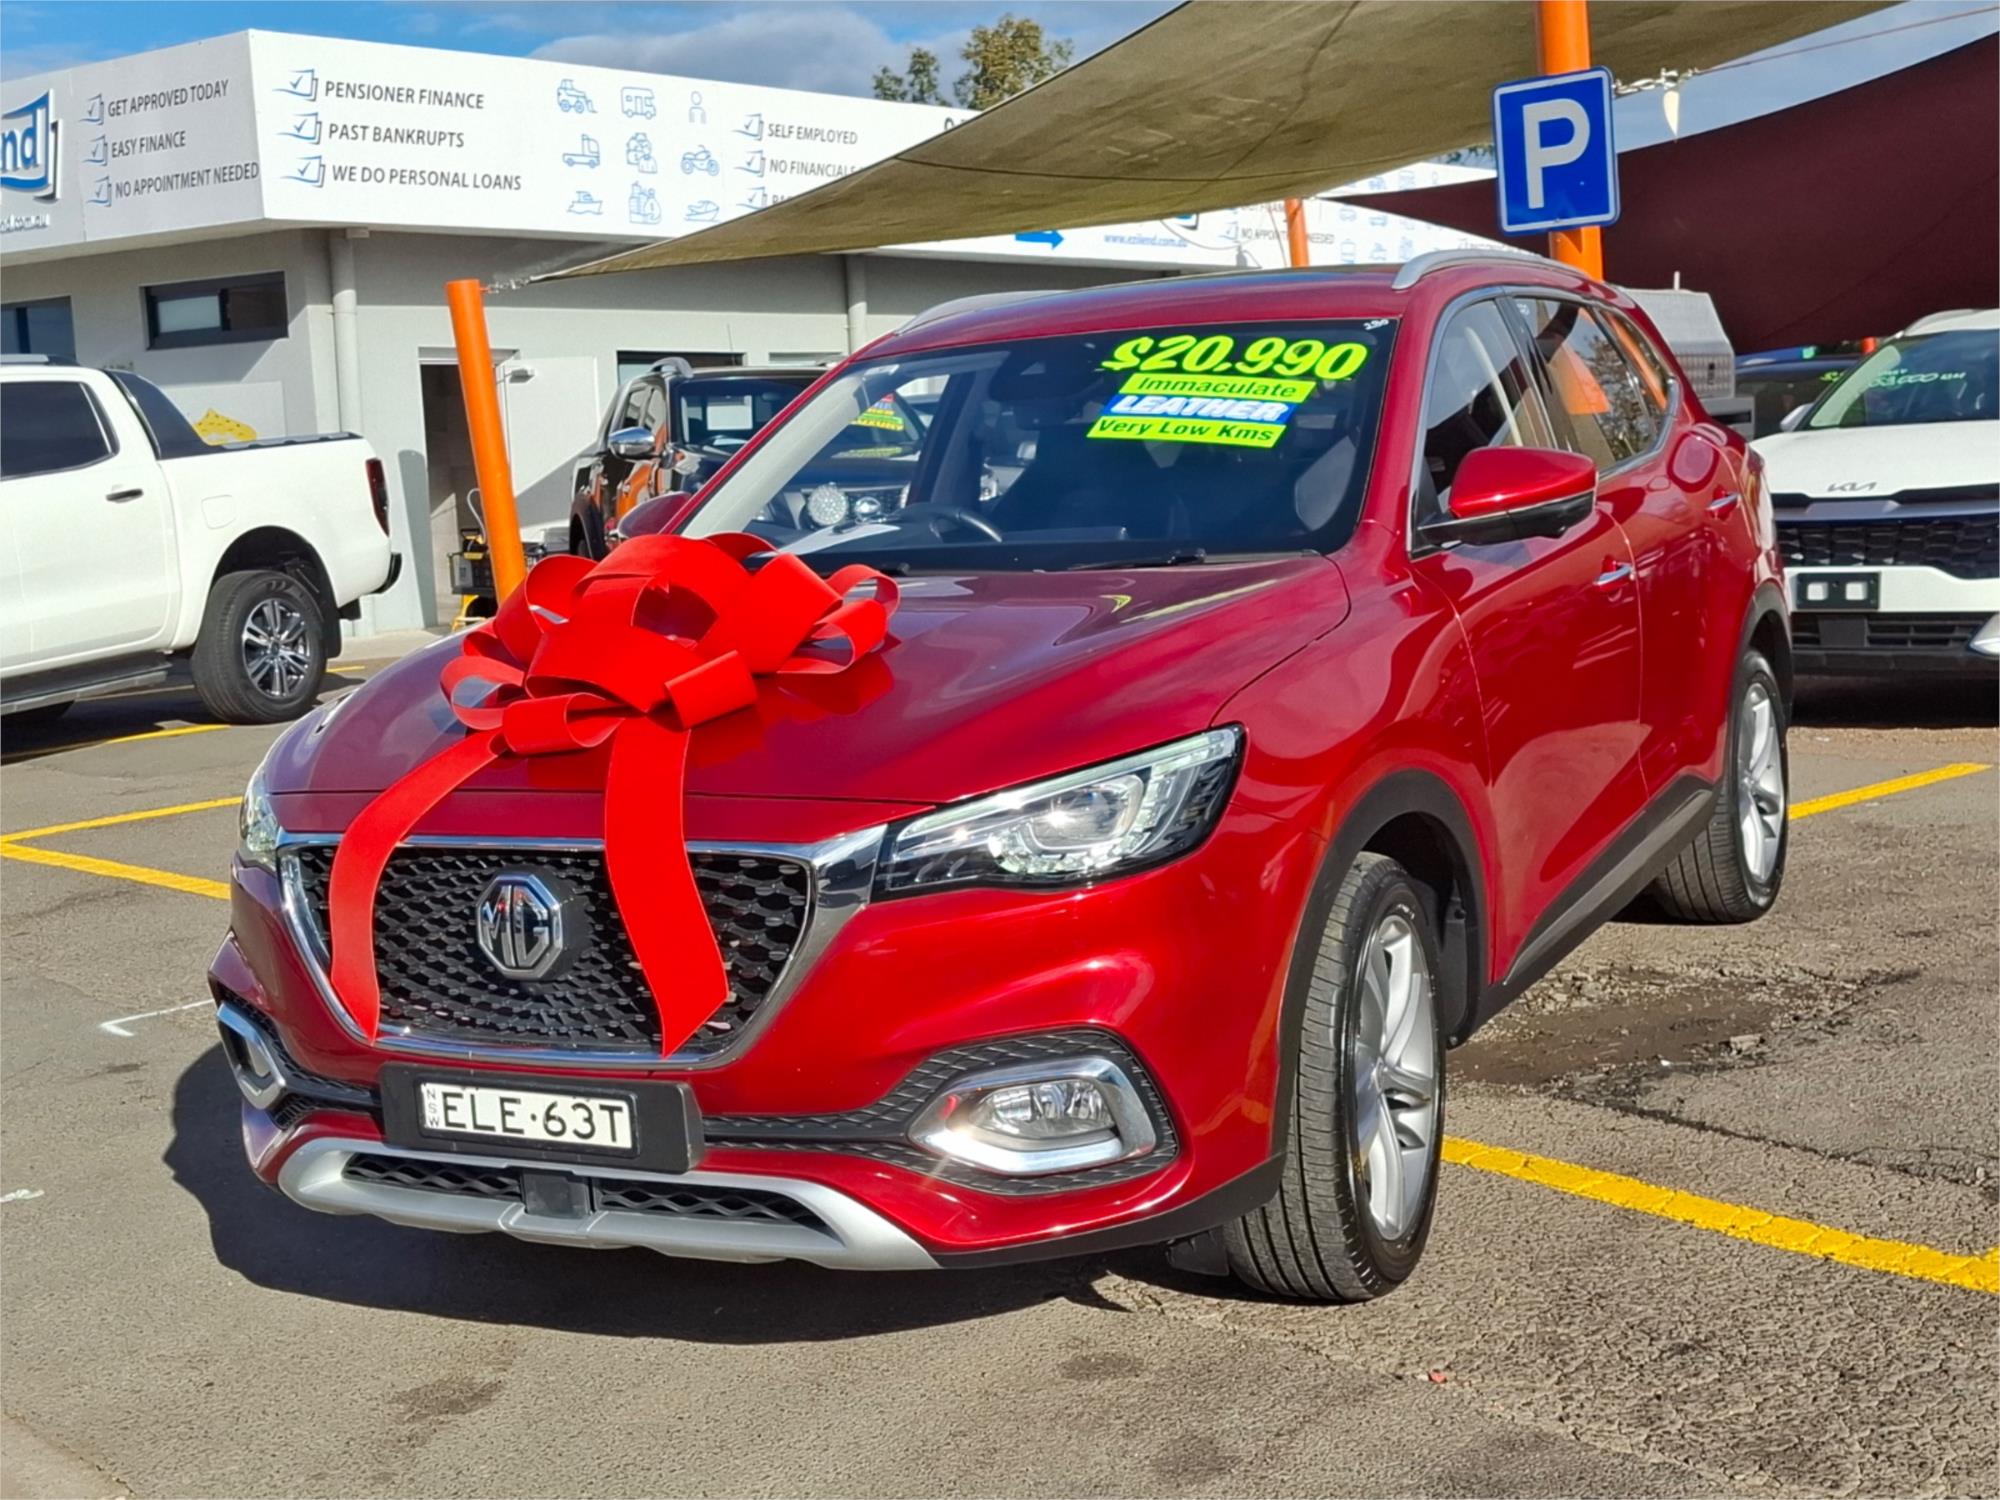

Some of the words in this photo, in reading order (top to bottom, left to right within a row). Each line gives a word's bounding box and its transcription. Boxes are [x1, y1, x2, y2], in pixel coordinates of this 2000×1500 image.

[108, 99, 128, 117] GET
[129, 88, 188, 114] APPROVED
[190, 79, 229, 103] TODAY
[325, 80, 415, 104] PENSIONER
[419, 89, 485, 109] FINANCE
[112, 137, 137, 158] EASY
[139, 130, 186, 153] FINANCE
[328, 123, 369, 141] PAST
[372, 126, 465, 148] BANKRUPTS
[767, 123, 793, 138] SELF
[796, 126, 858, 145] EMPLOYED
[769, 159, 787, 174] NO
[1522, 98, 1590, 209] P
[115, 181, 131, 199] NO
[133, 169, 211, 195] APPOINTMENT
[214, 162, 260, 184] NEEDED
[332, 165, 357, 181] WE
[361, 166, 385, 183] DO
[389, 168, 469, 188] PERSONAL
[472, 173, 522, 191] LOANS
[1137, 377, 1297, 398] Immaculate
[1110, 395, 1289, 421] LEATHER
[1098, 419, 1153, 438] Very
[1157, 421, 1210, 436] Low
[1215, 426, 1275, 441] Kms
[481, 884, 550, 970] MG
